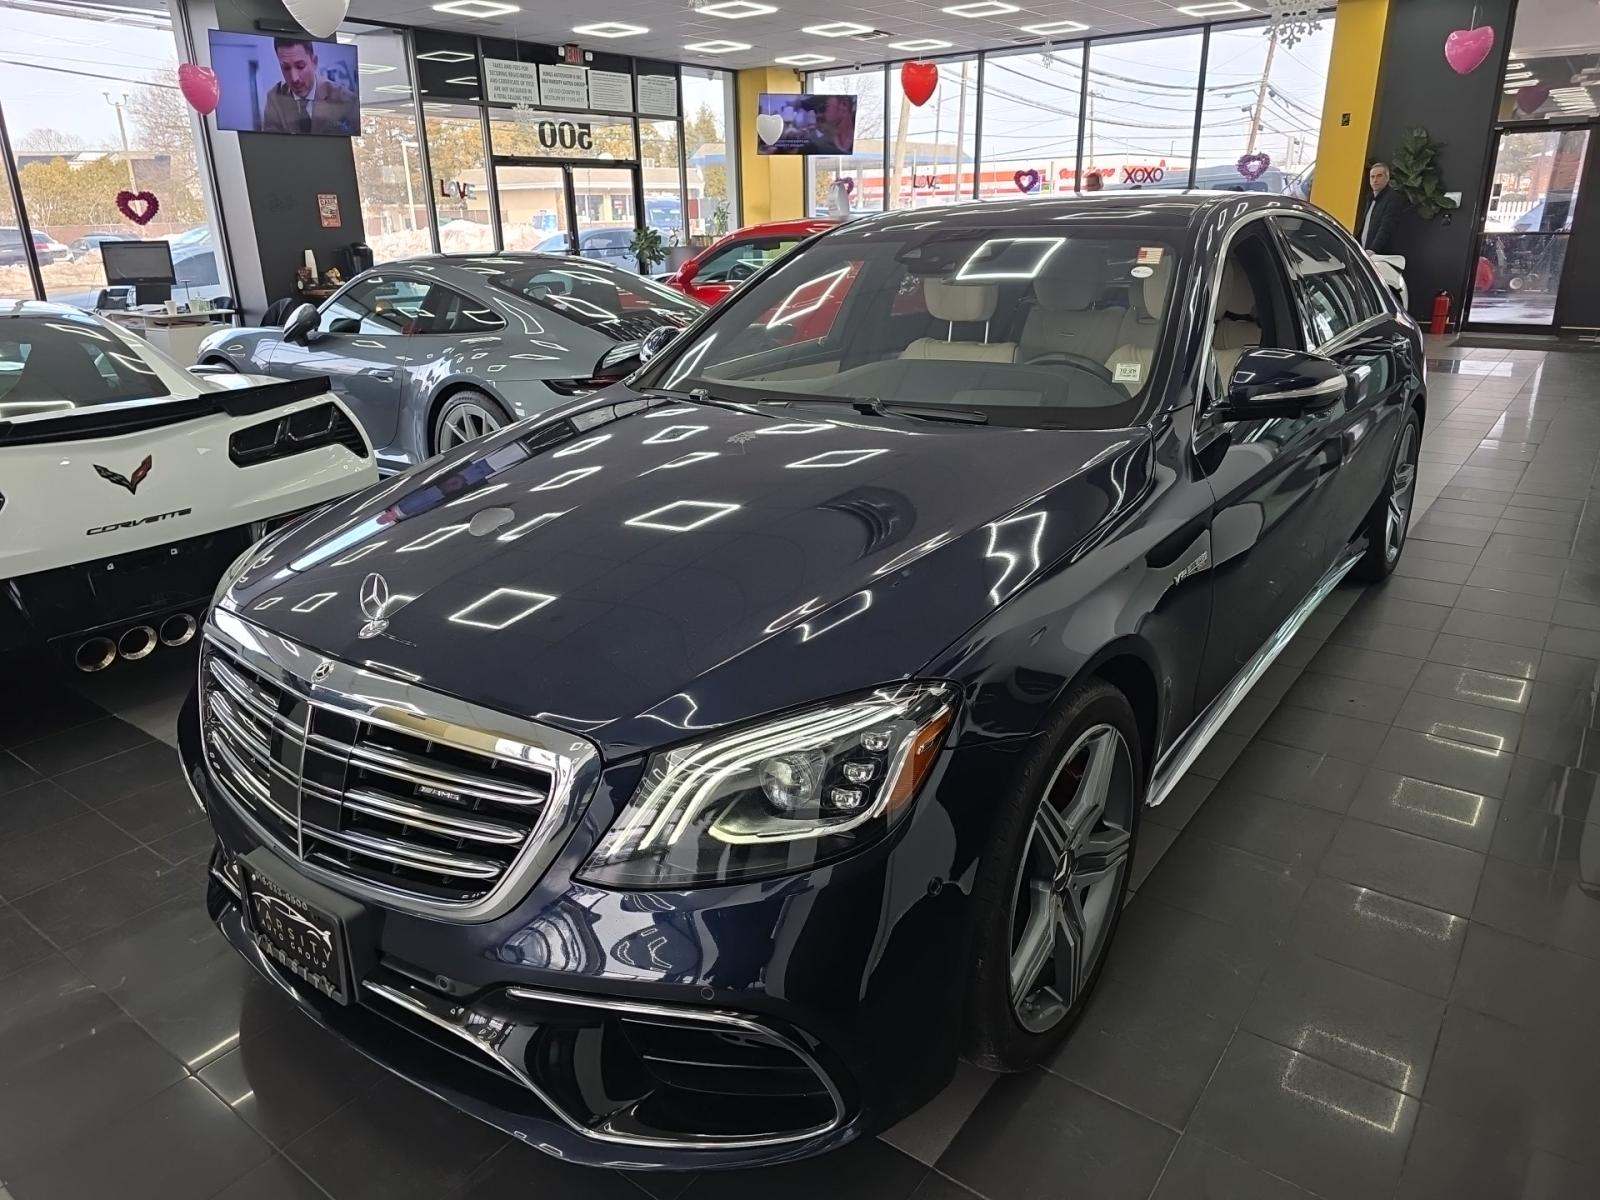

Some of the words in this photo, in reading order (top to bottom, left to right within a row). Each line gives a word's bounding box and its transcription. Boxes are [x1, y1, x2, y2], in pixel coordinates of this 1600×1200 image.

[1123, 167, 1164, 183] XOXO
[440, 179, 477, 200] LOVE
[86, 507, 192, 535] CORVETTE
[254, 899, 332, 962] VARSITY
[260, 919, 284, 941] AUTO
[290, 941, 327, 969] GROUP
